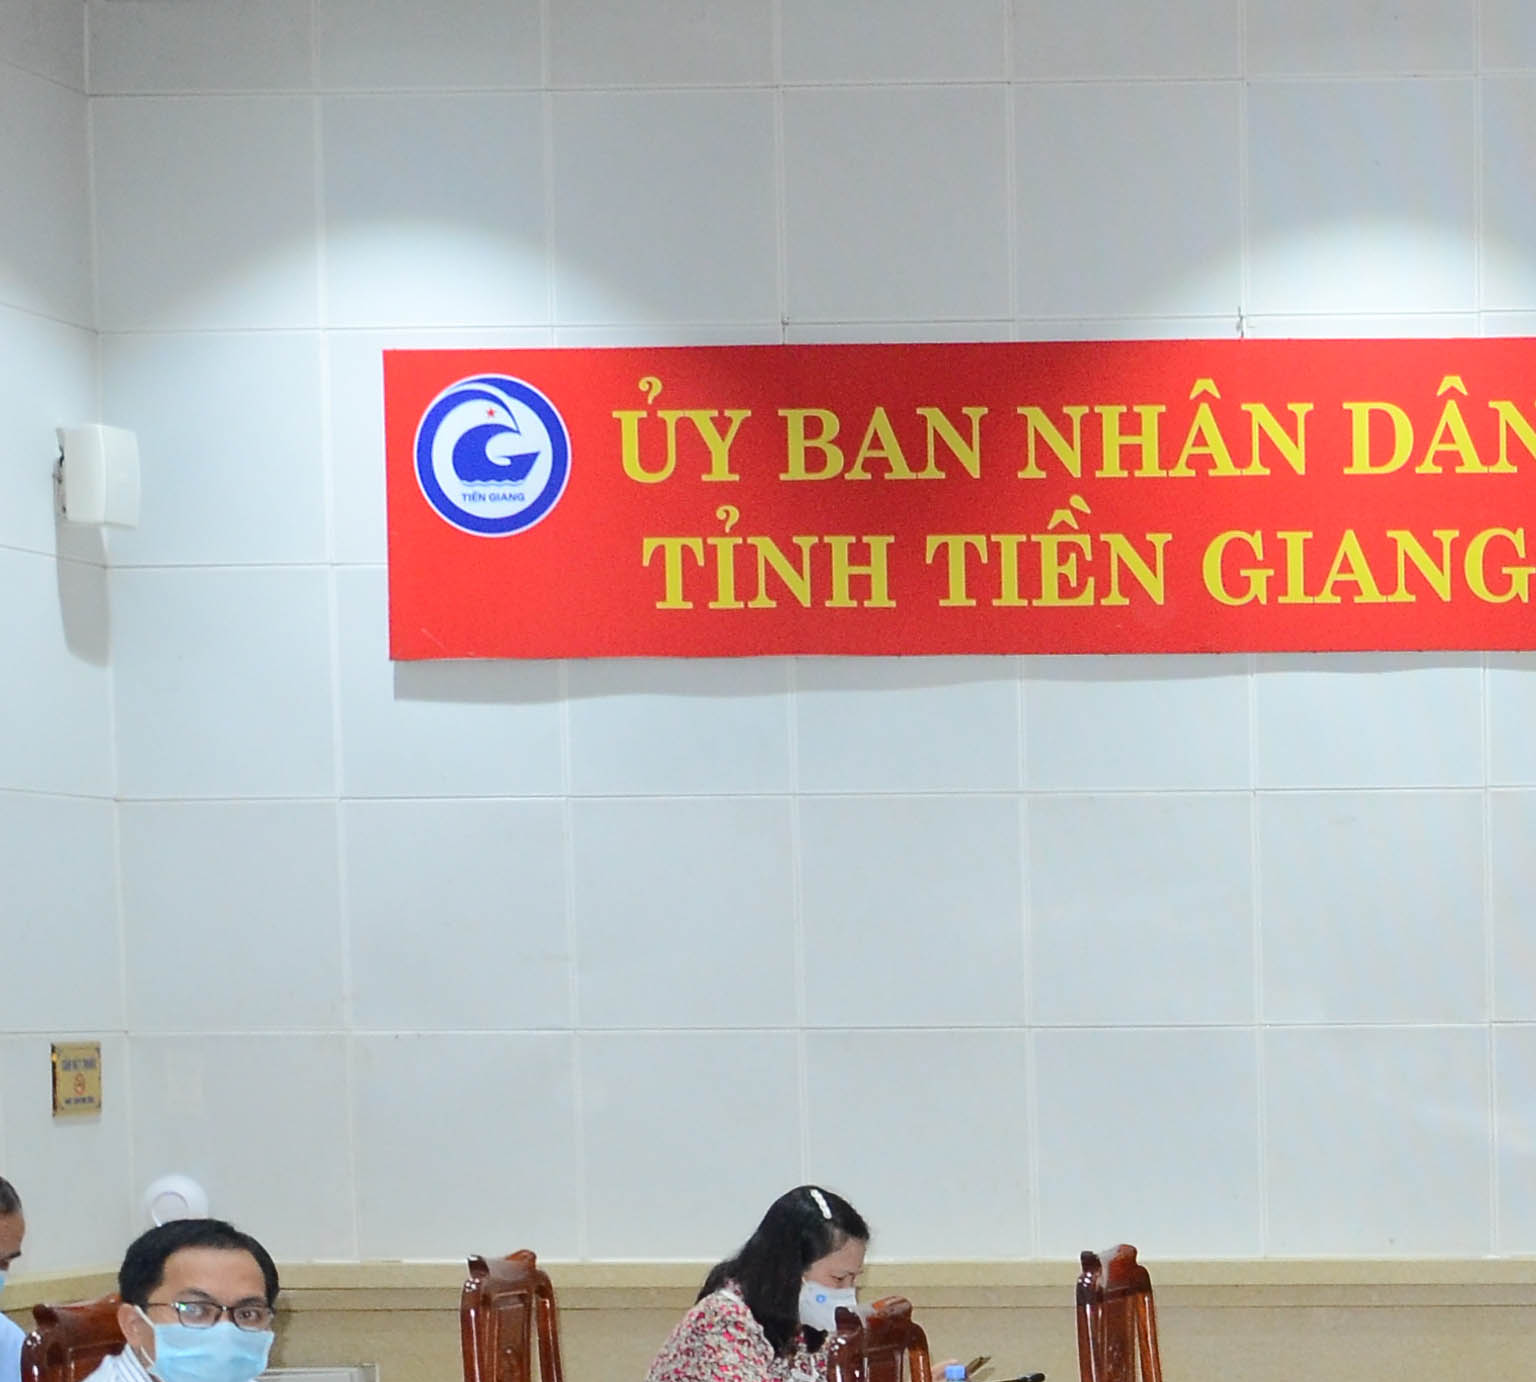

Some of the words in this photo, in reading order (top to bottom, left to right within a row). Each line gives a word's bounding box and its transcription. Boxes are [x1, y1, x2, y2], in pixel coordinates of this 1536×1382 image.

[612, 376, 752, 484] ỦY
[778, 407, 988, 480] BAN
[1017, 378, 1315, 478] NHÂN
[642, 505, 896, 610] TỈNH
[926, 495, 1173, 607] TIỀN
[1203, 526, 1536, 606] GIANG
